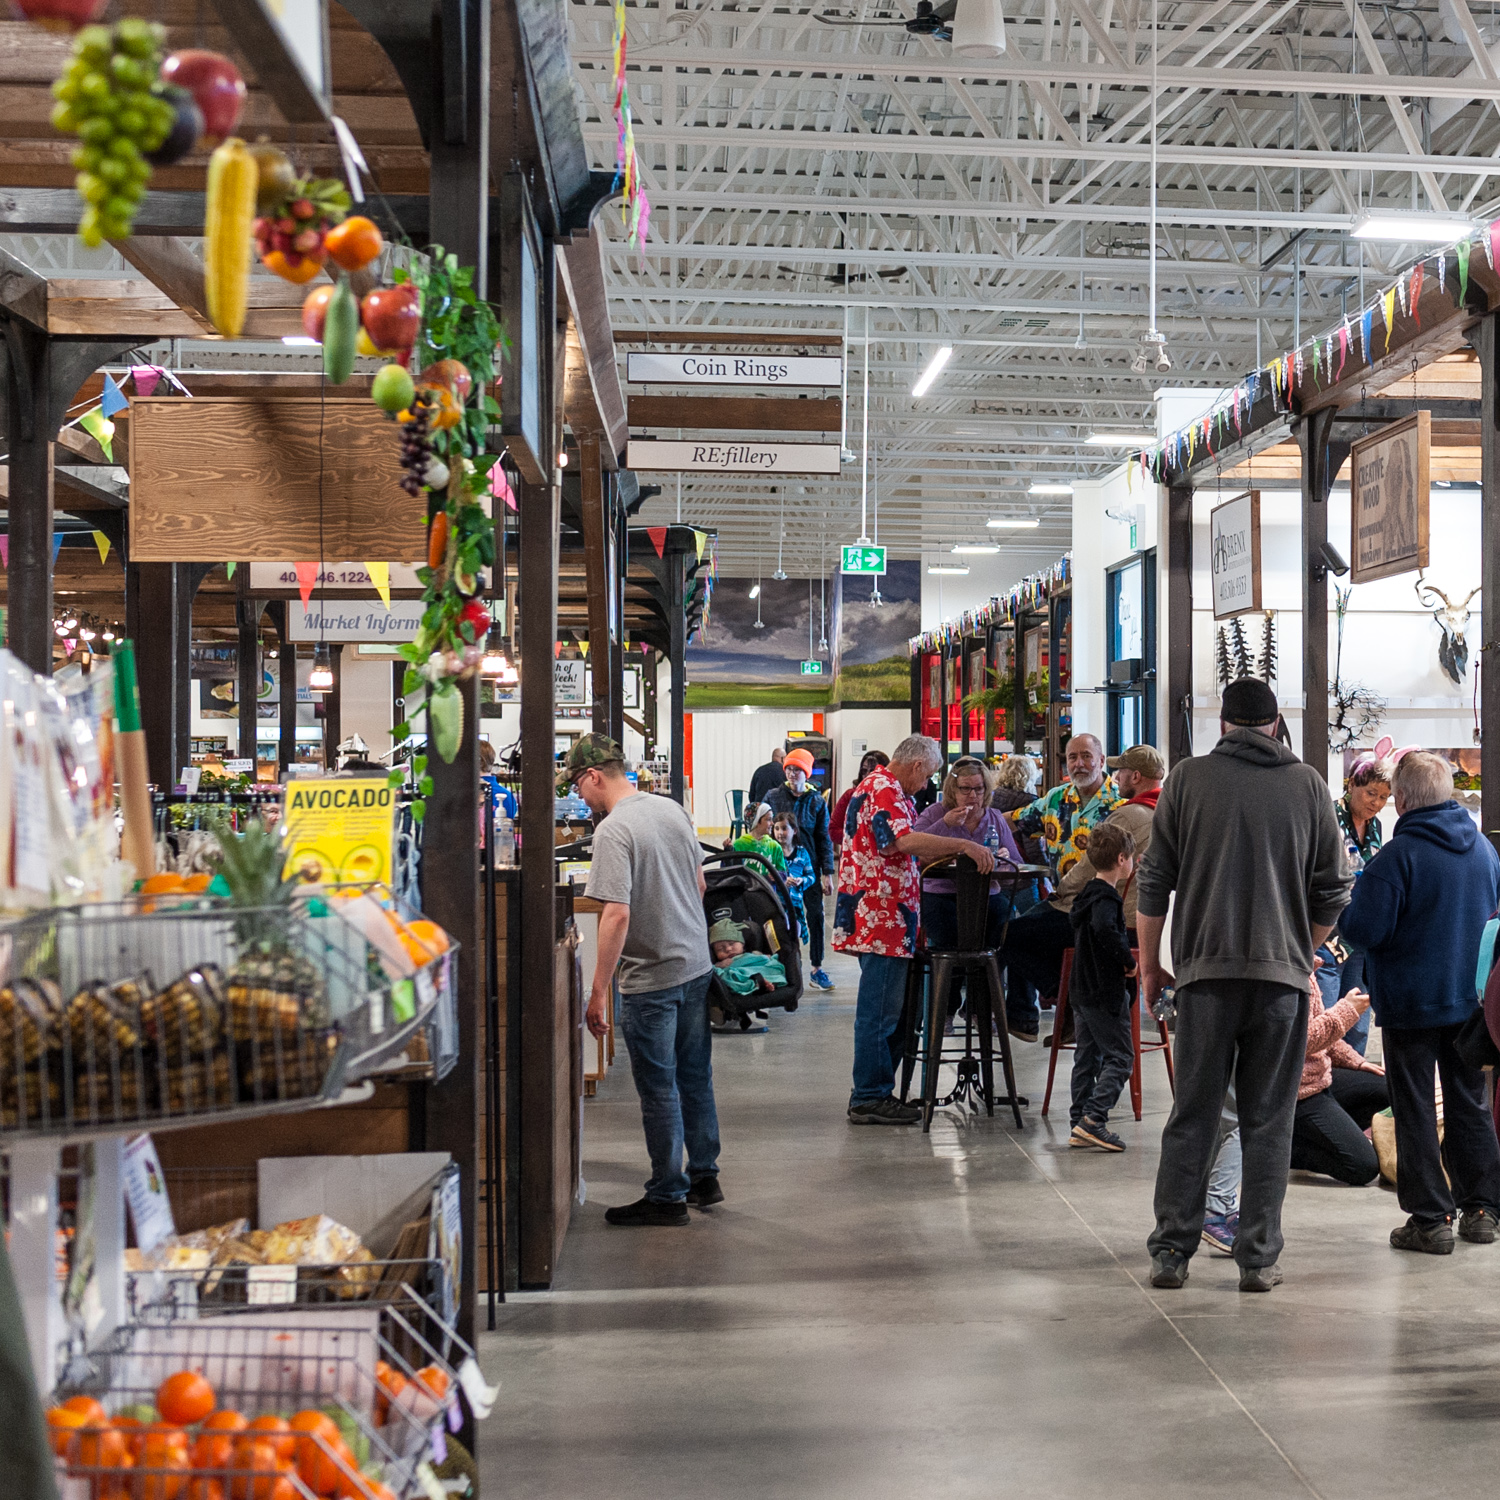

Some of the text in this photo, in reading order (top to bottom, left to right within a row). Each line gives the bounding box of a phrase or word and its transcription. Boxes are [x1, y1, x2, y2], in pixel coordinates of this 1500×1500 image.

[682, 358, 788, 381] Coin Rings
[691, 446, 778, 468] RE:fillery
[1358, 457, 1385, 488] CREATIVE
[1362, 484, 1380, 511] WOOD
[304, 612, 421, 634] Market Inform
[291, 788, 390, 809] AVOCADO
